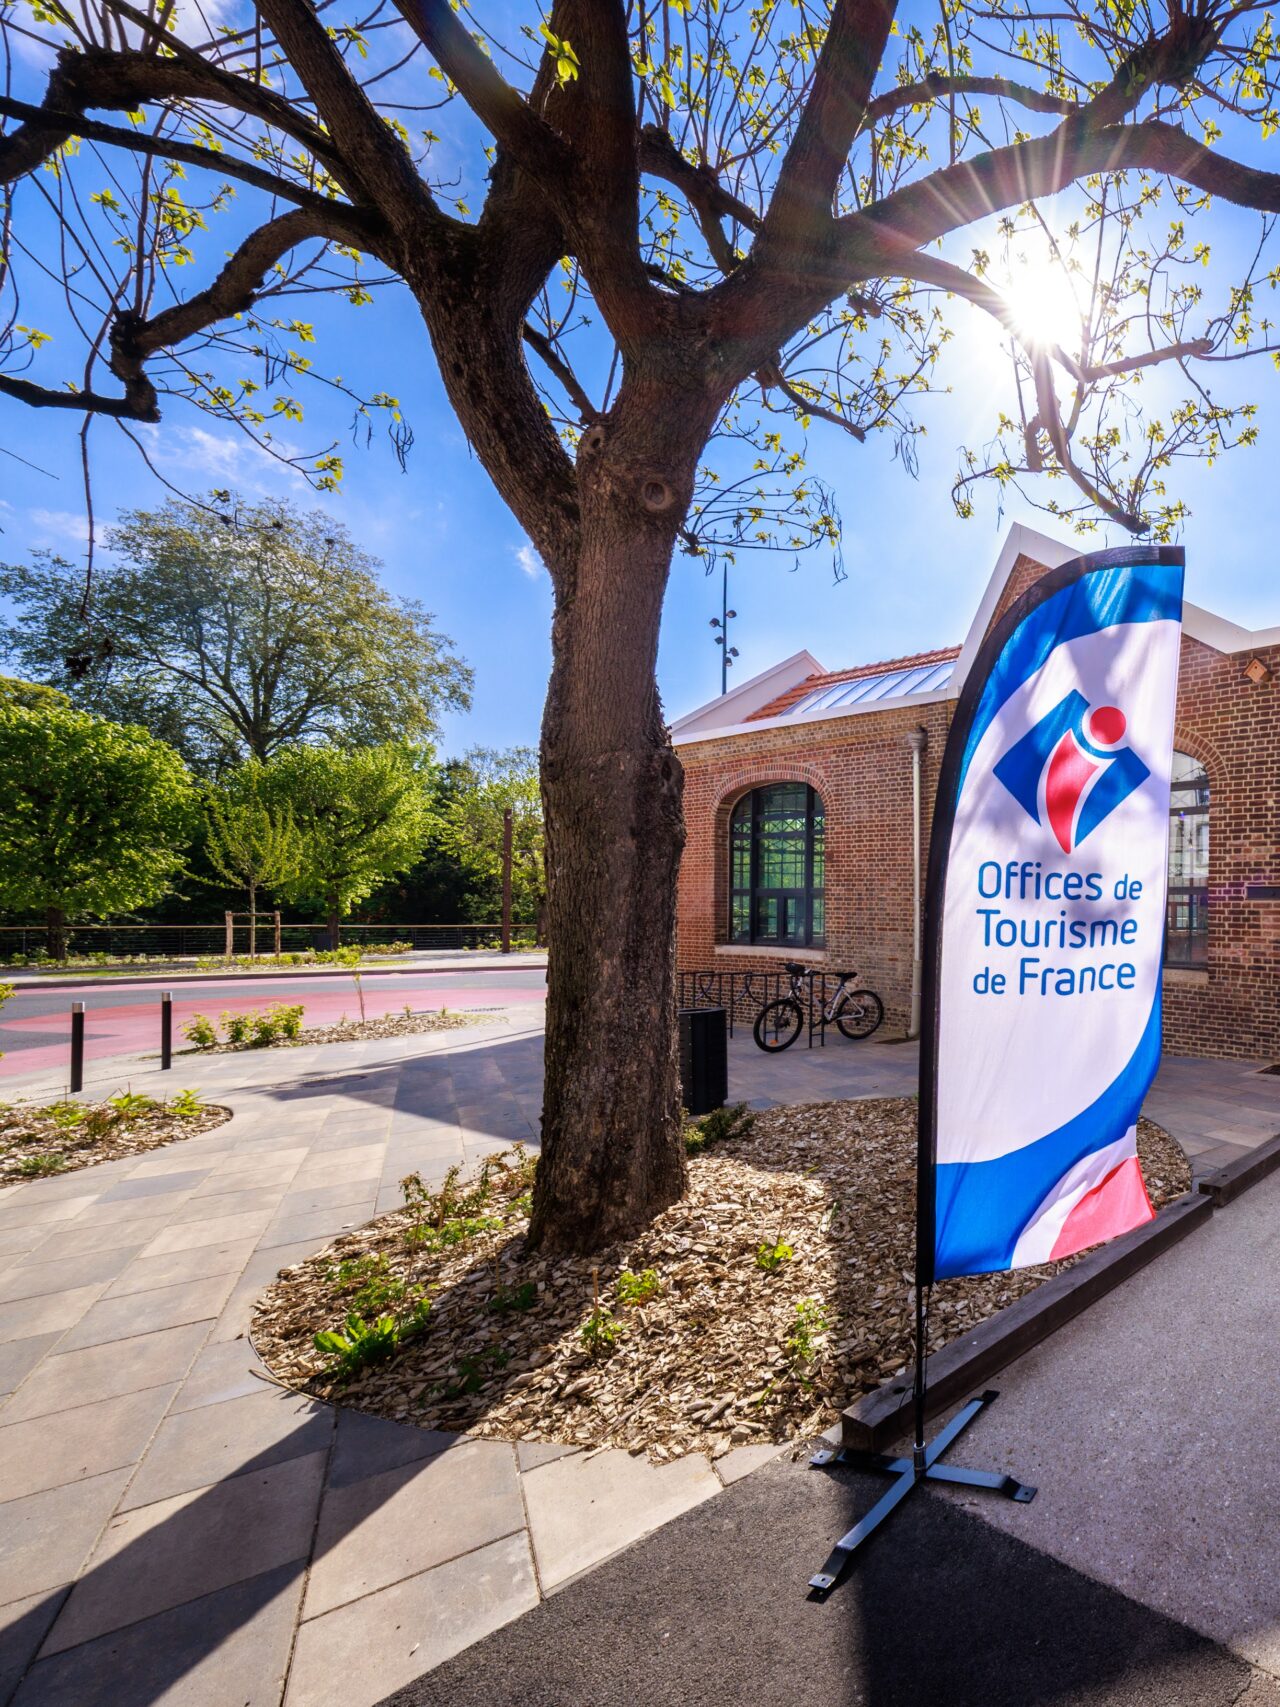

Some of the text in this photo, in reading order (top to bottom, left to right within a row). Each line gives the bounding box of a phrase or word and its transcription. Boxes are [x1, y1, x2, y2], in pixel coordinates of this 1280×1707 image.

[977, 861, 1143, 901] Offices de
[976, 908, 1138, 949] Tourisme
[973, 957, 1136, 996] de France
